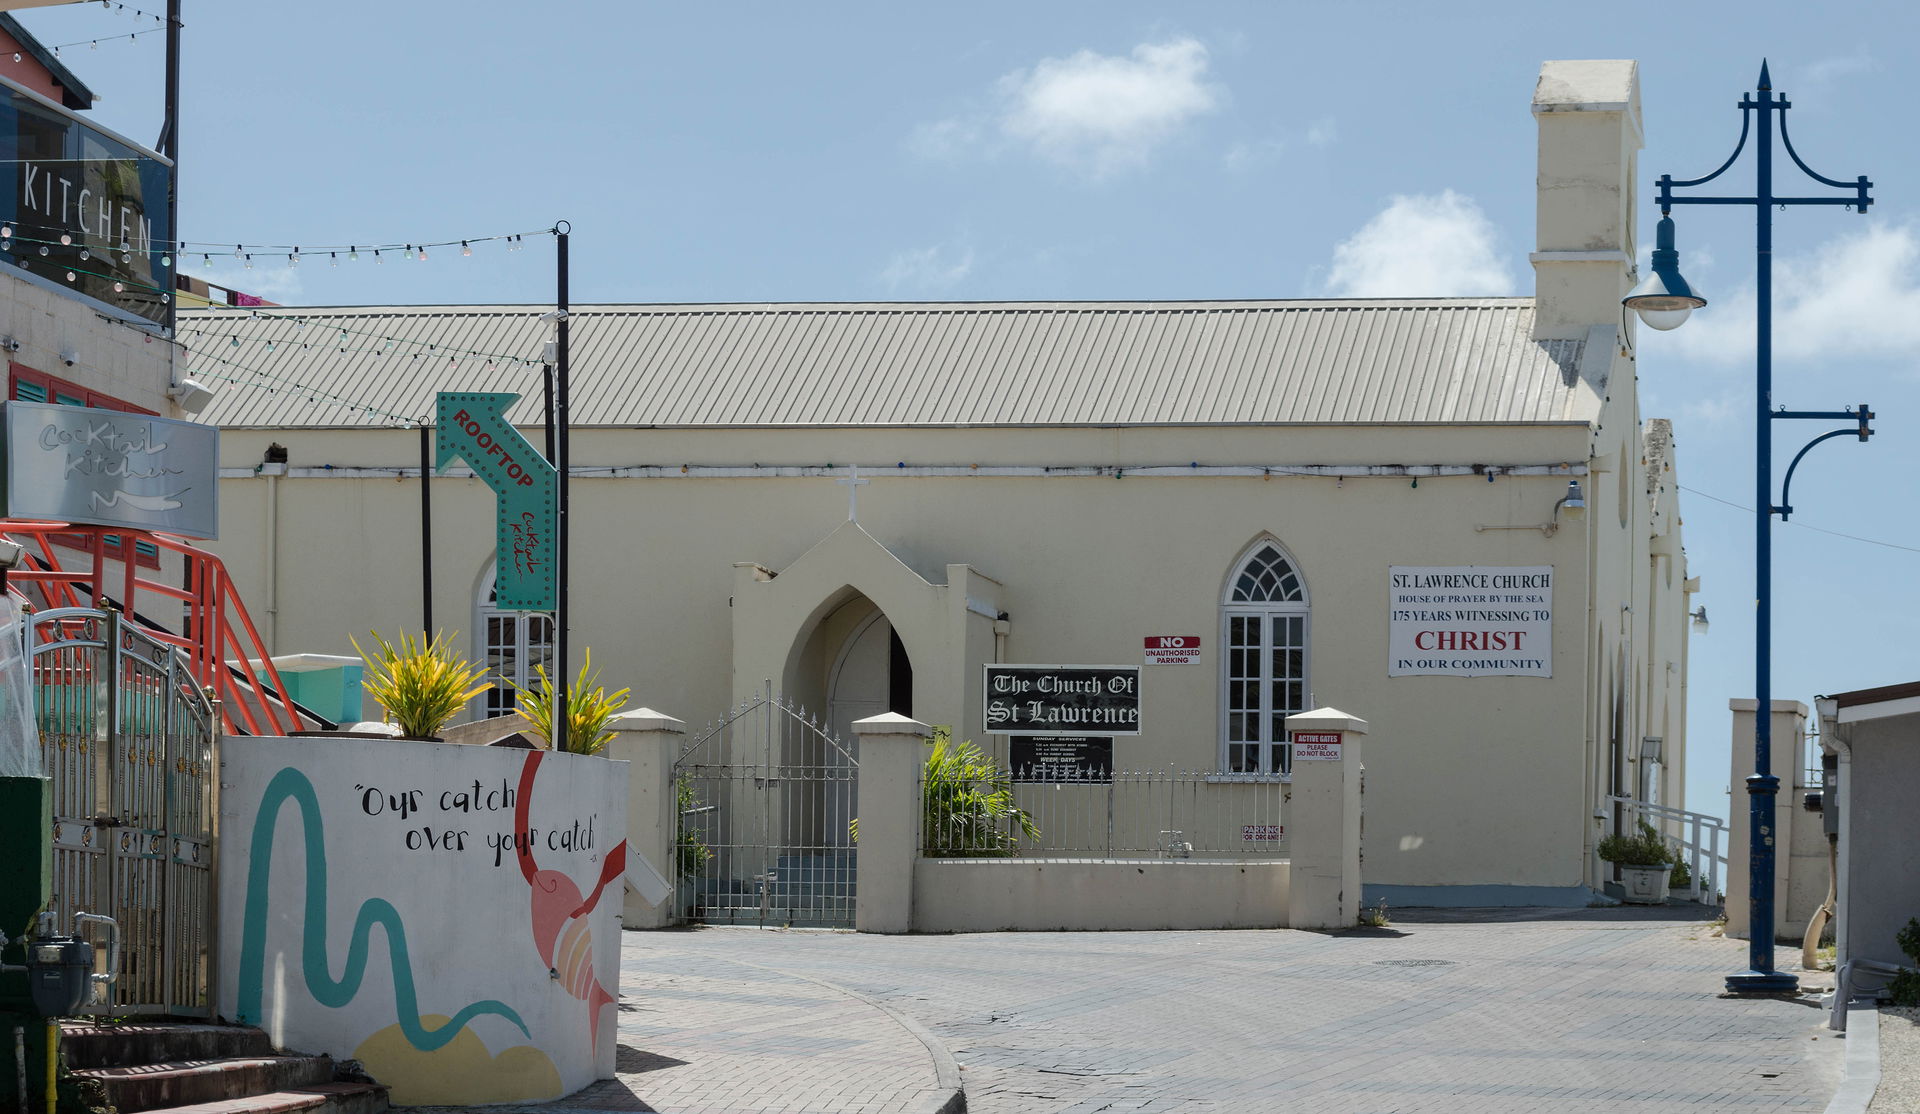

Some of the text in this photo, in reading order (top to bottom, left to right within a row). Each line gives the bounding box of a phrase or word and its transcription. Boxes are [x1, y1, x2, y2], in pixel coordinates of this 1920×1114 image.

[24, 161, 152, 260] KITCHEN
[452, 408, 534, 487] ROOFTOP
[64, 449, 184, 480] Kitchen
[1393, 574, 1550, 589] ST. LAWRENCE CHURCH
[1399, 595, 1544, 603] HOUSE OF PRAYER BY THE SEA
[1393, 610, 1549, 622] 175 YEARS WITNESSING TO
[1160, 637, 1184, 647] NO
[1414, 631, 1527, 651] CHRIST
[1398, 659, 1545, 669] IN OUR COMMUNITY
[993, 674, 1135, 696] The Church Of
[987, 699, 1138, 724] St Lawrence
[1298, 735, 1338, 743] ACTIVE GATES
[439, 778, 515, 813] catch
[405, 826, 469, 851] over
[487, 827, 539, 867] your
